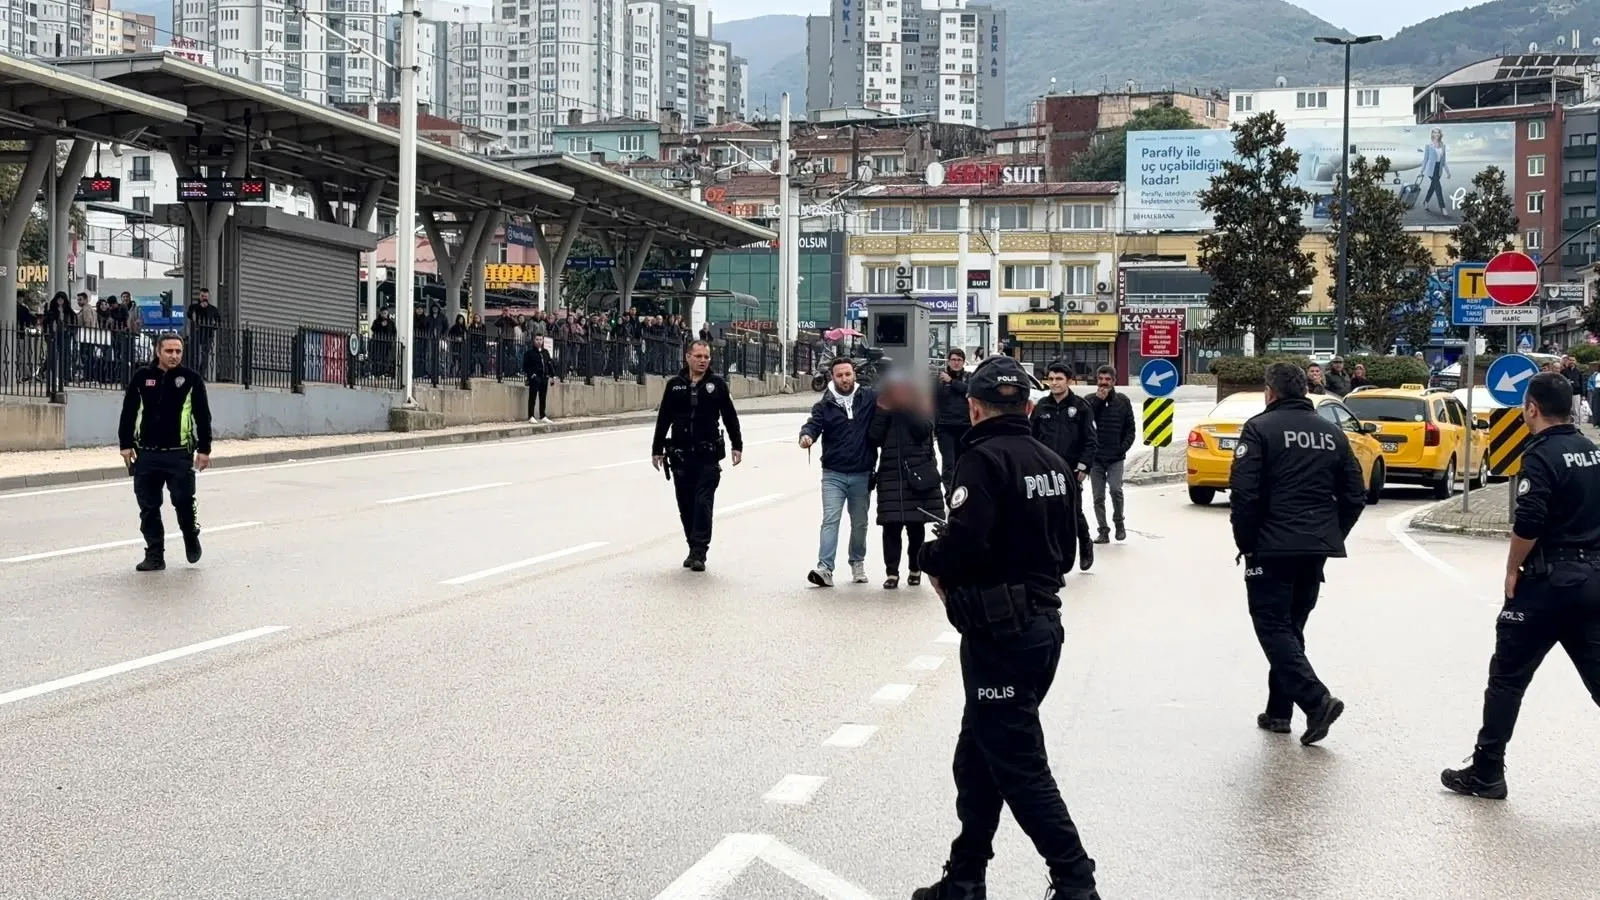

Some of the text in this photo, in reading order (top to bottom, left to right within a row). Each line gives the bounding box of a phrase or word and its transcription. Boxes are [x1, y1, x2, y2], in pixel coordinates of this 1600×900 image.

[1141, 146, 1201, 159] Parafly ile
[1002, 166, 1043, 183] SUIT
[1141, 163, 1157, 174] uç
[1141, 174, 1180, 186] kadar!
[798, 237, 827, 248] OLSUN
[977, 685, 1016, 700] POLIS
